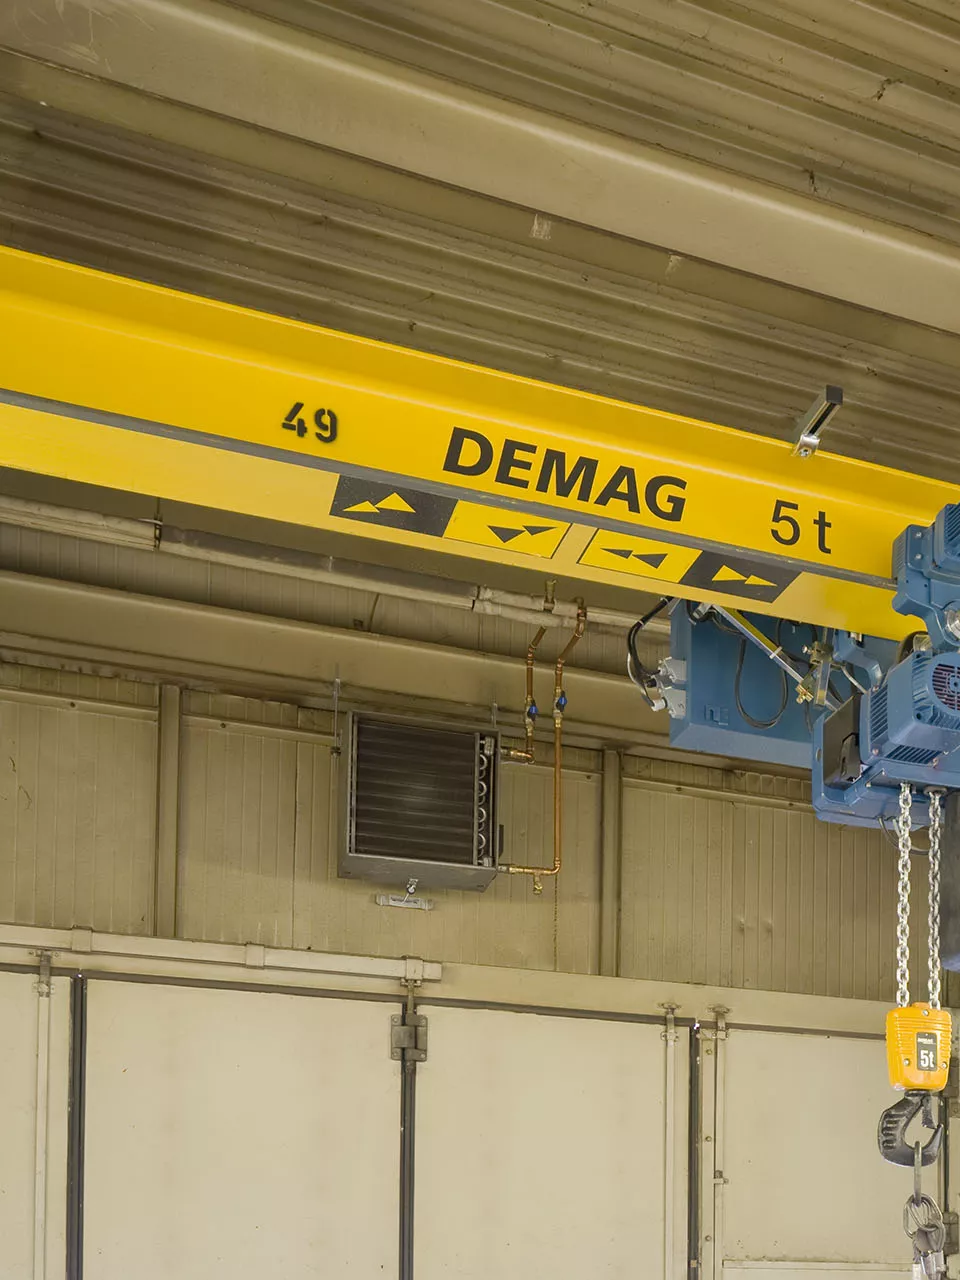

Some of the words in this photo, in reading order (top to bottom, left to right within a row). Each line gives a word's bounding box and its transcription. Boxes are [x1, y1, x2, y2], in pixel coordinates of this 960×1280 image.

[282, 401, 338, 443] 49
[443, 426, 688, 522] DEMAG
[920, 1050, 935, 1068] 5t
